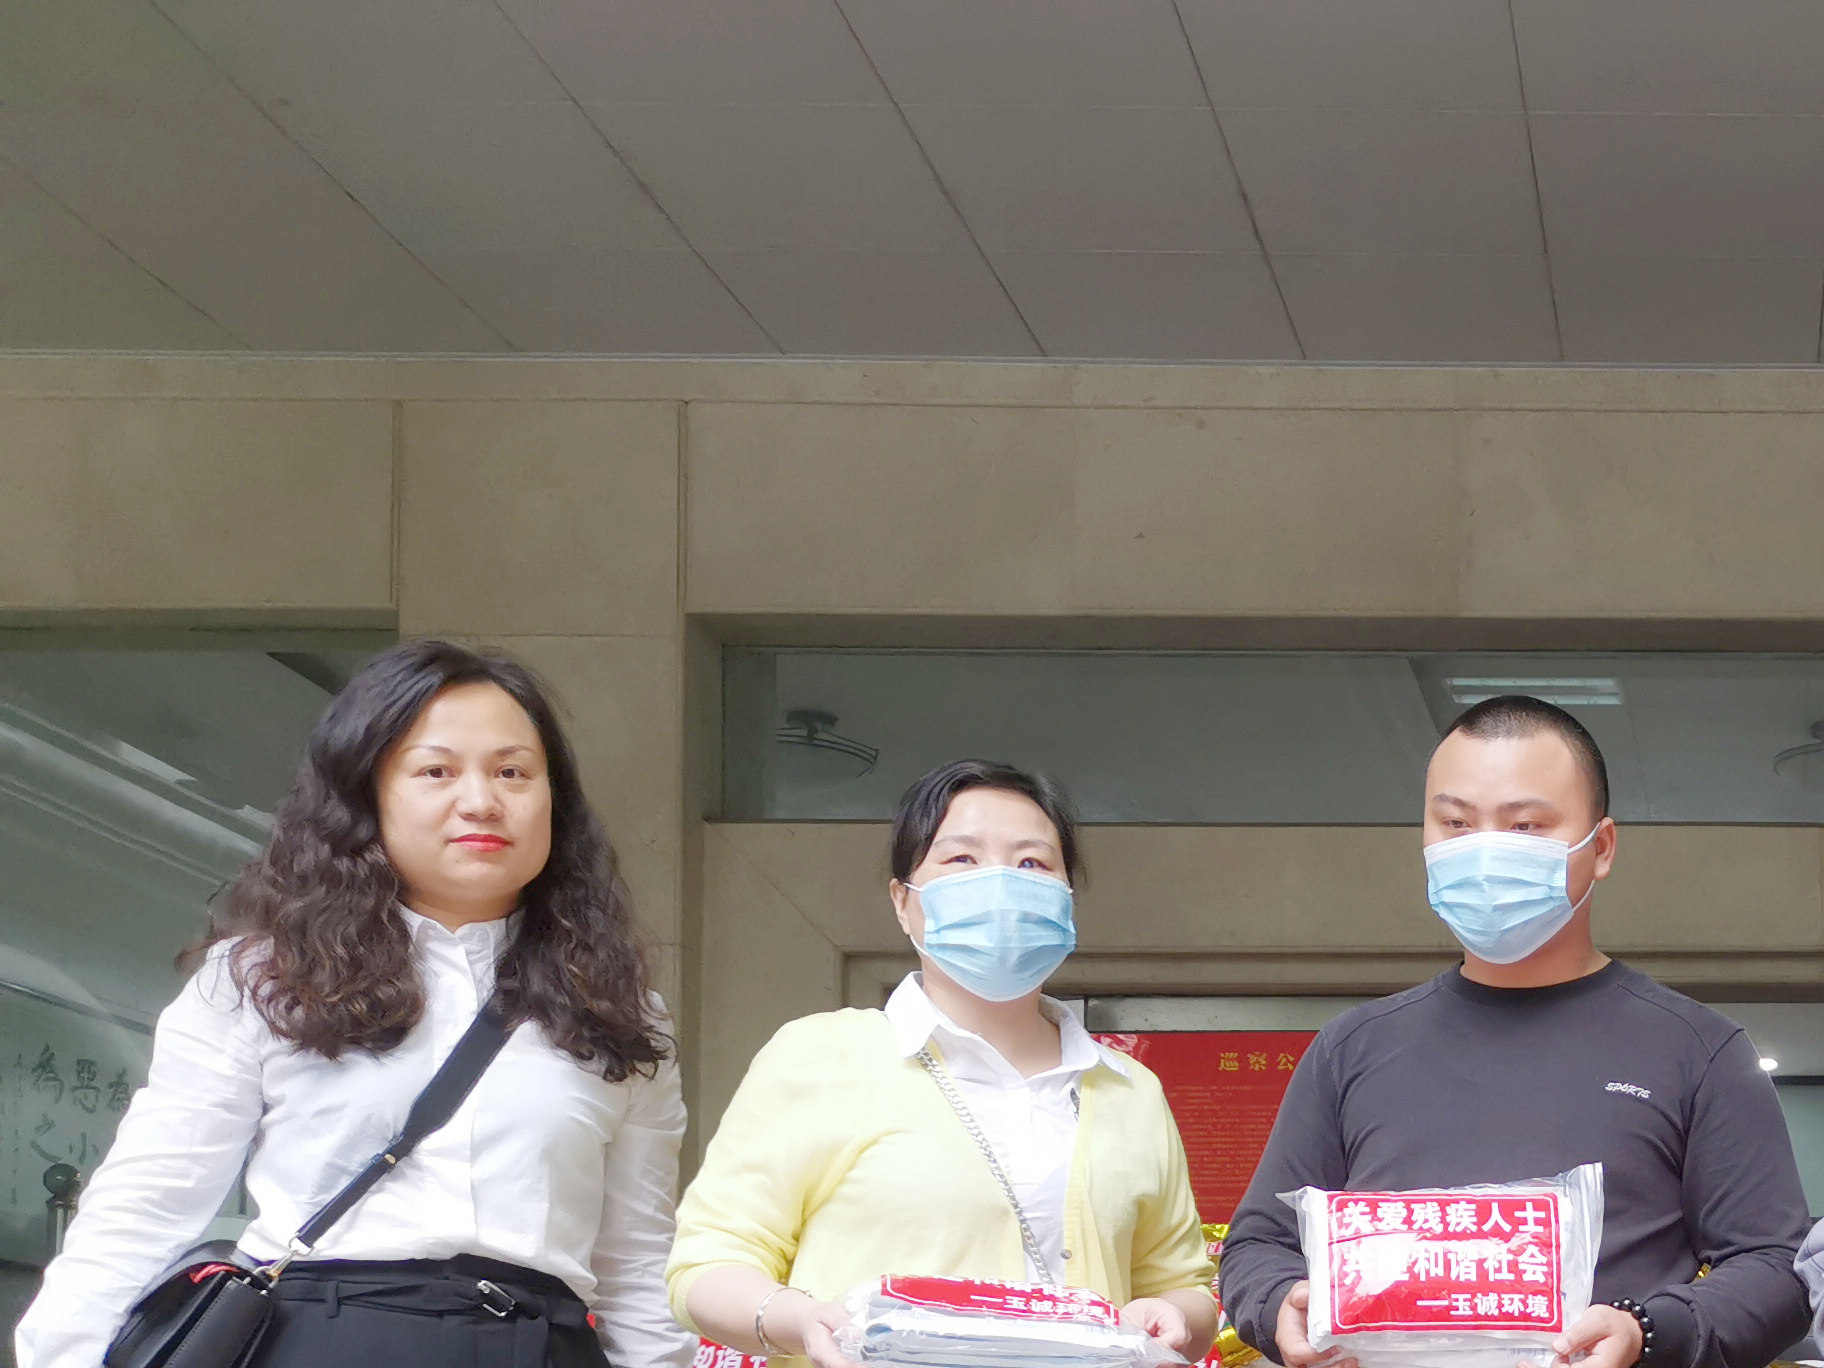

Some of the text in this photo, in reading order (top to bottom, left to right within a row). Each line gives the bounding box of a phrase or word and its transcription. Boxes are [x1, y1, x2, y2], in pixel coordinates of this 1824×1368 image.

[1342, 1200, 1547, 1235] 关爱残疾人士
